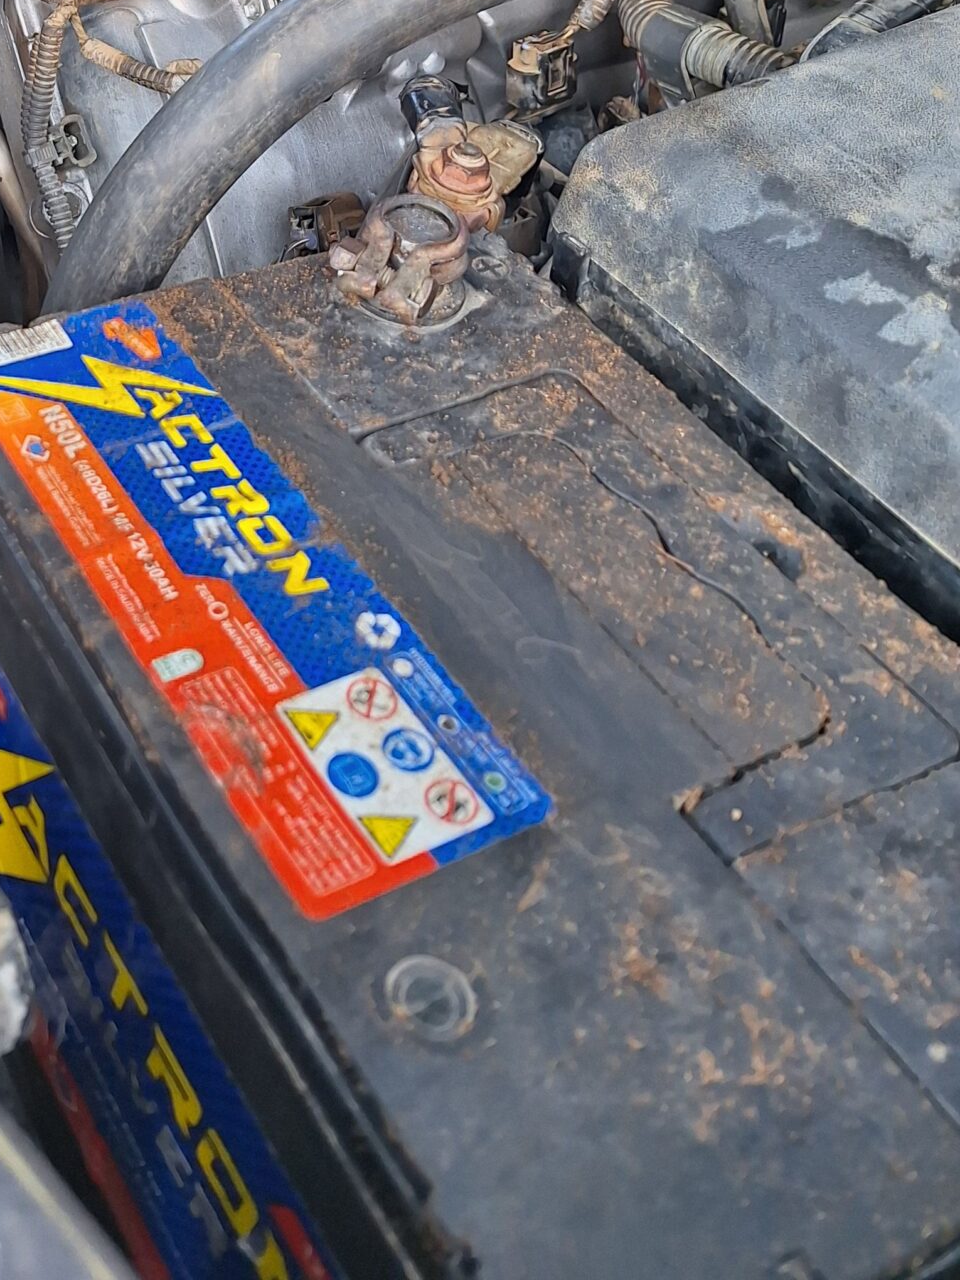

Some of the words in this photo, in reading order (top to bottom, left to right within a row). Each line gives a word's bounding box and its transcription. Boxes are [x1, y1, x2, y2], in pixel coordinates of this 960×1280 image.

[38, 403, 89, 458] N50L
[136, 383, 330, 596] ACTRON
[136, 439, 258, 578] SILVER
[194, 582, 230, 621] ZERO
[243, 620, 273, 653] LONG
[265, 651, 291, 677] LIFE
